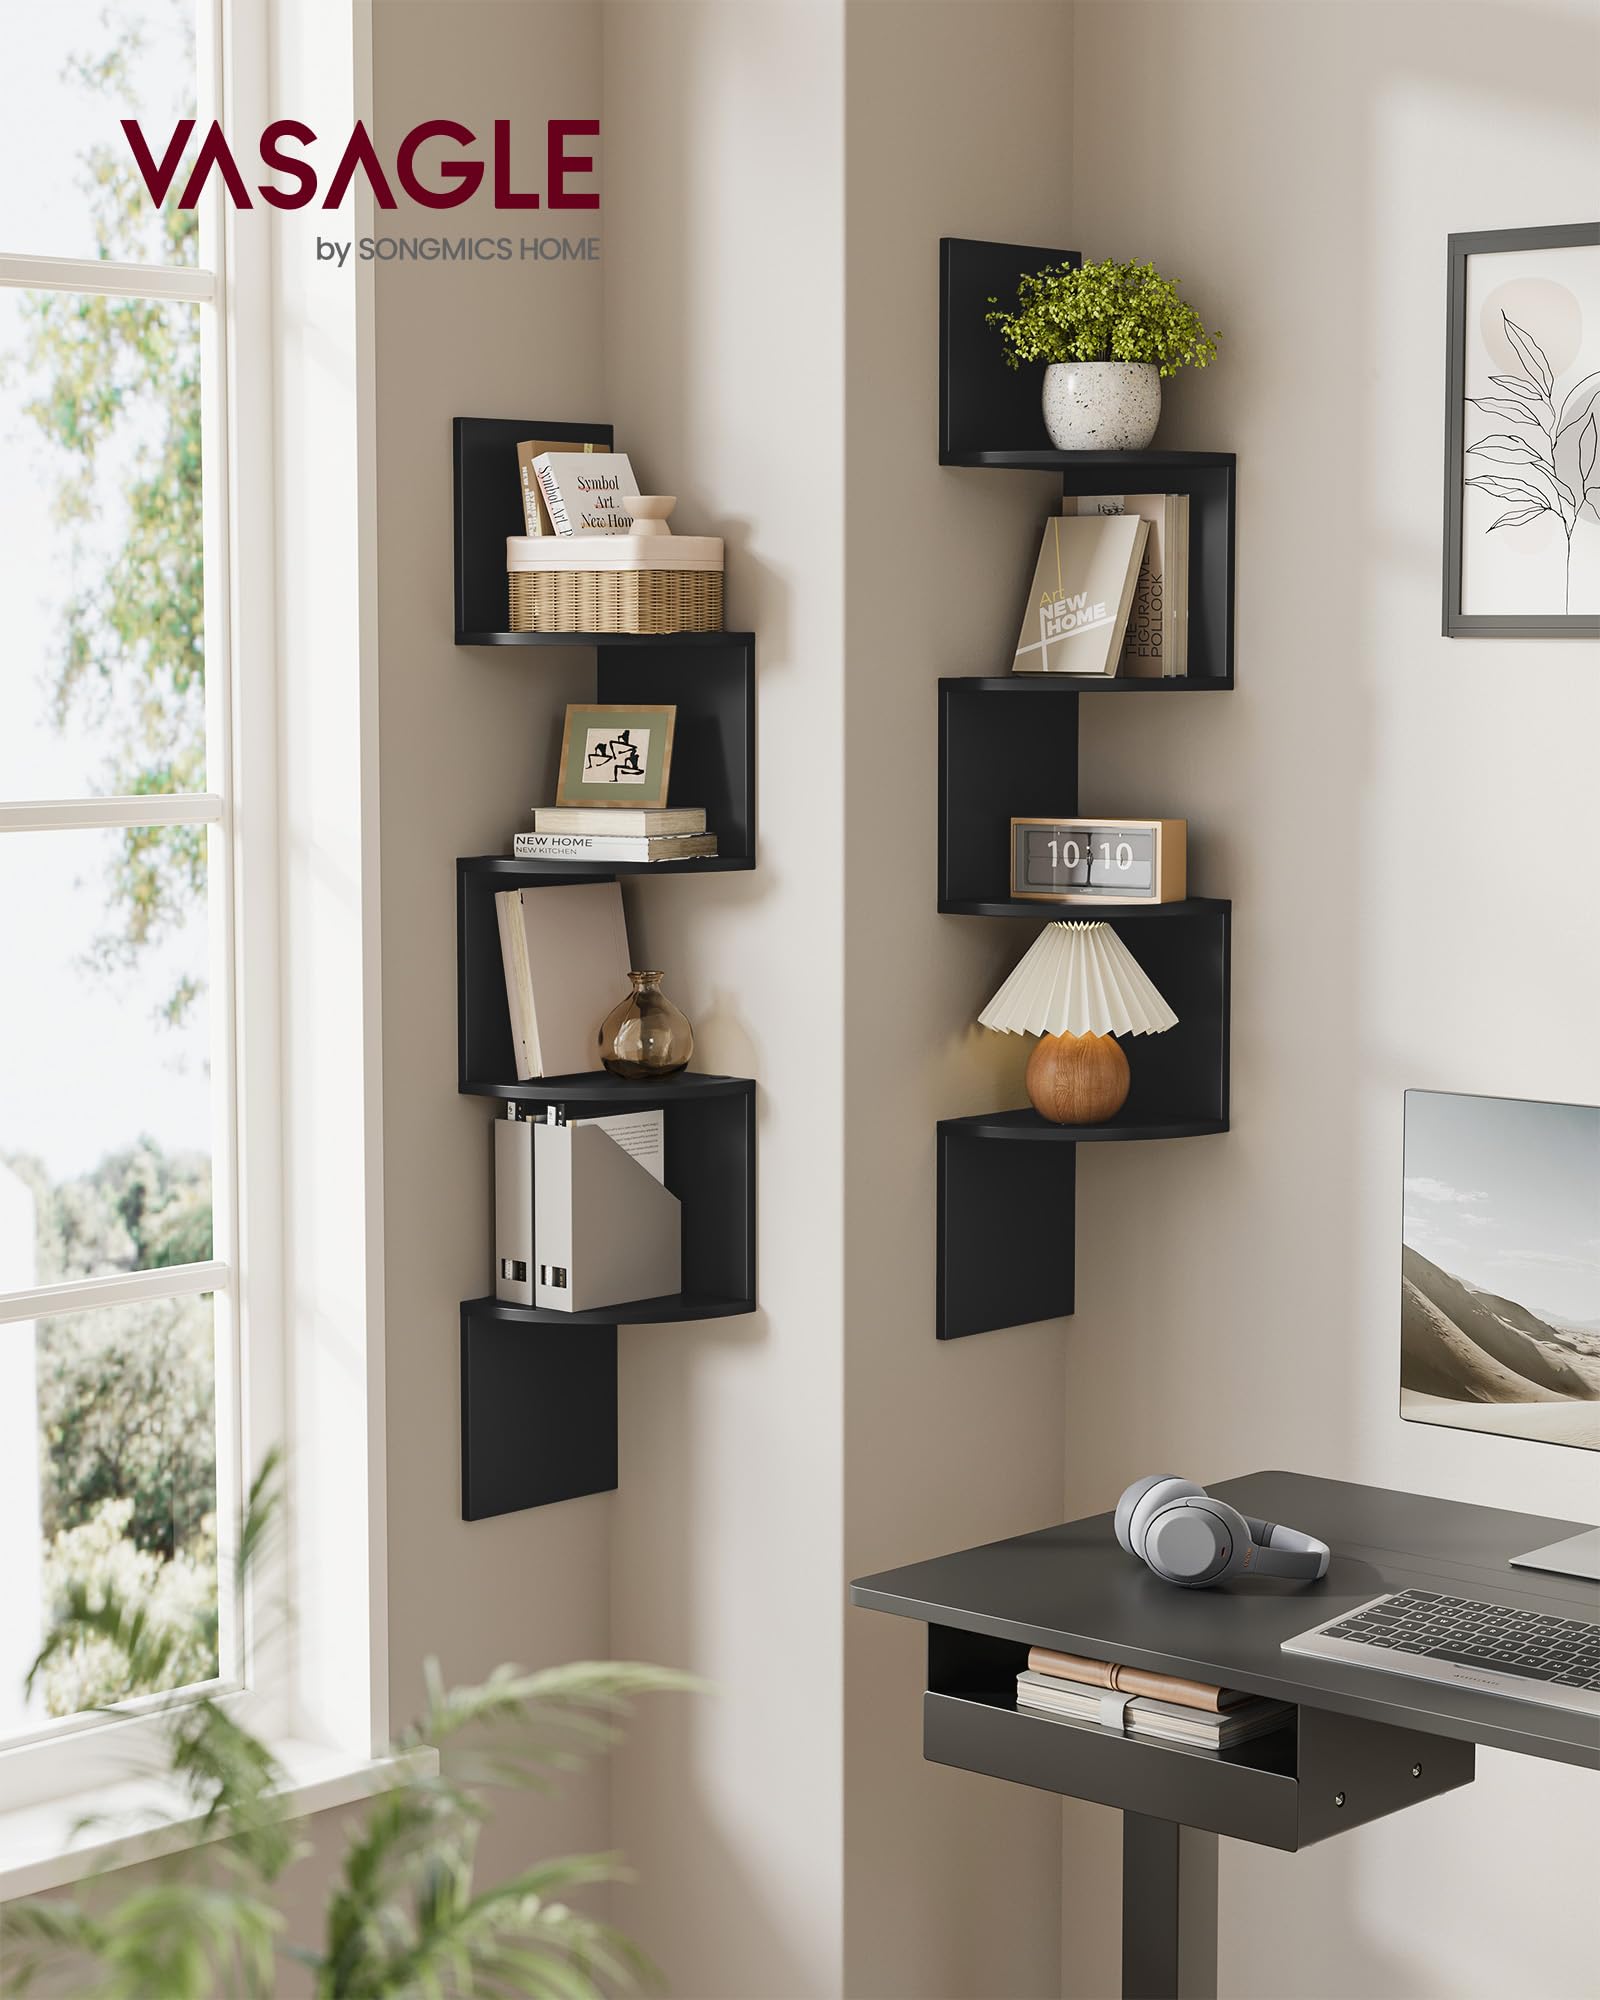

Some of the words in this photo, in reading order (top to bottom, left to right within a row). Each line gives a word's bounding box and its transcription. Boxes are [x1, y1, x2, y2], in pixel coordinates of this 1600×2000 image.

[538, 465, 564, 505] Symbol
[577, 474, 620, 493] Symbol
[580, 512, 607, 529] New
[608, 513, 635, 528] Hom
[1040, 588, 1065, 608] Art
[1040, 592, 1088, 620] NEW
[1047, 602, 1107, 637] HOME
[1151, 574, 1163, 658] POLLOCK
[516, 837, 548, 845] NEW
[552, 838, 593, 847] HOME
[539, 847, 577, 855] KITCHEN
